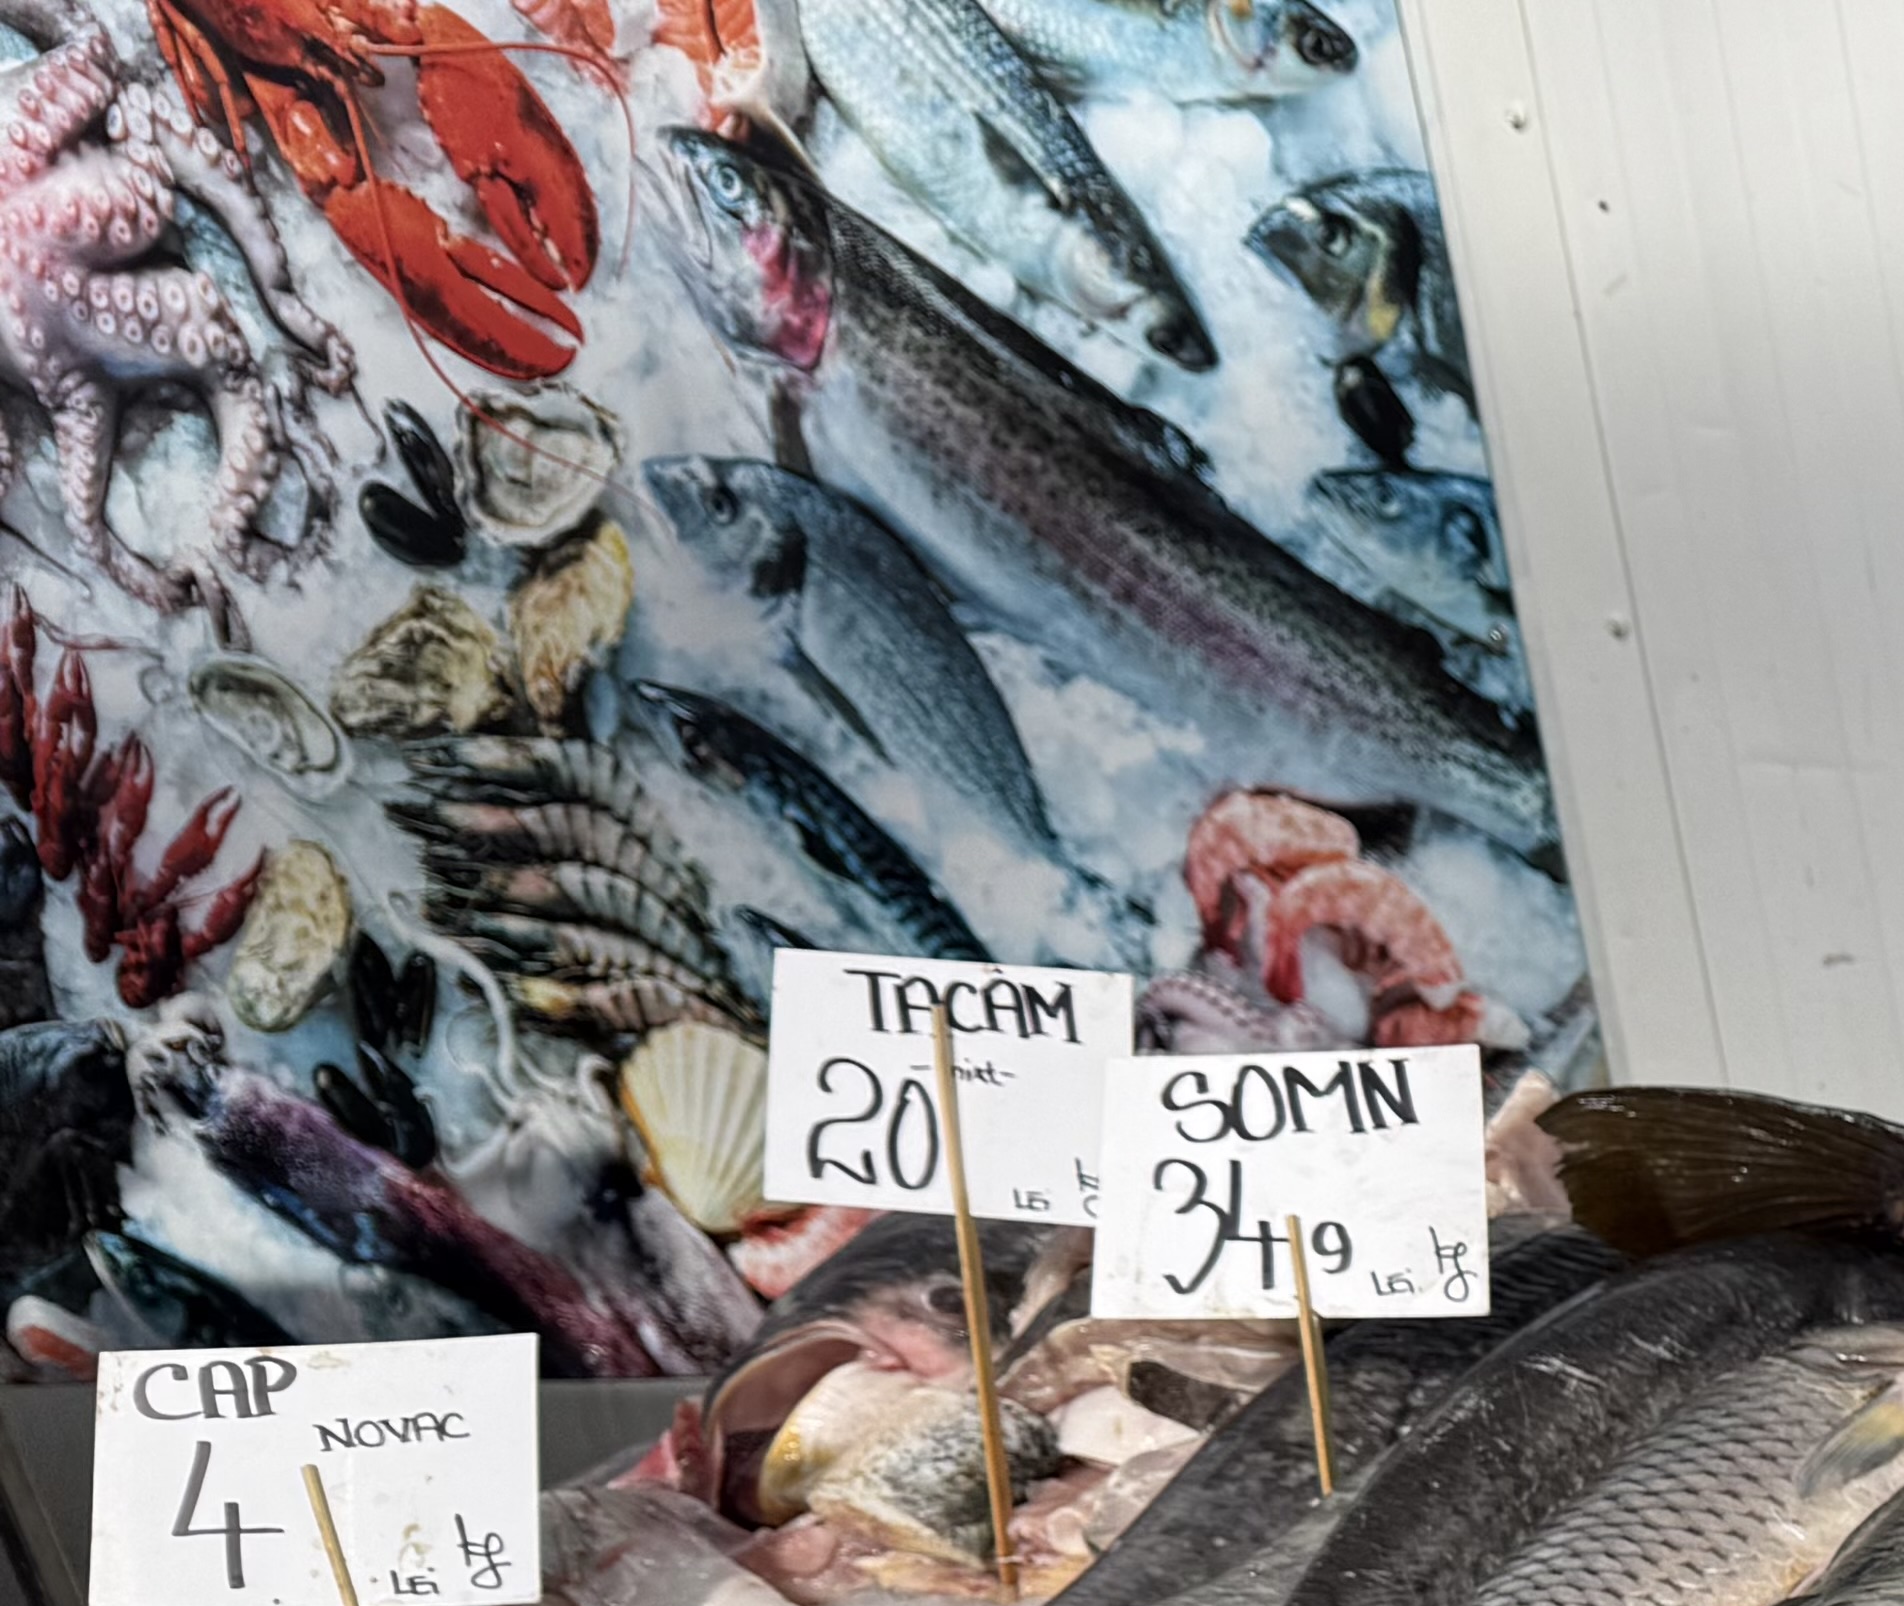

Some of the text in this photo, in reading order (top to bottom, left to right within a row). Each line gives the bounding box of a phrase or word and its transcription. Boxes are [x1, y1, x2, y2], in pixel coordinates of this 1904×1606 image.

[807, 1058, 939, 1190] 20
[1161, 1059, 1418, 1143] SOMN
[132, 1355, 298, 1421] CAP
[313, 1412, 470, 1451] NOVAC
[172, 1441, 284, 1589] 4
